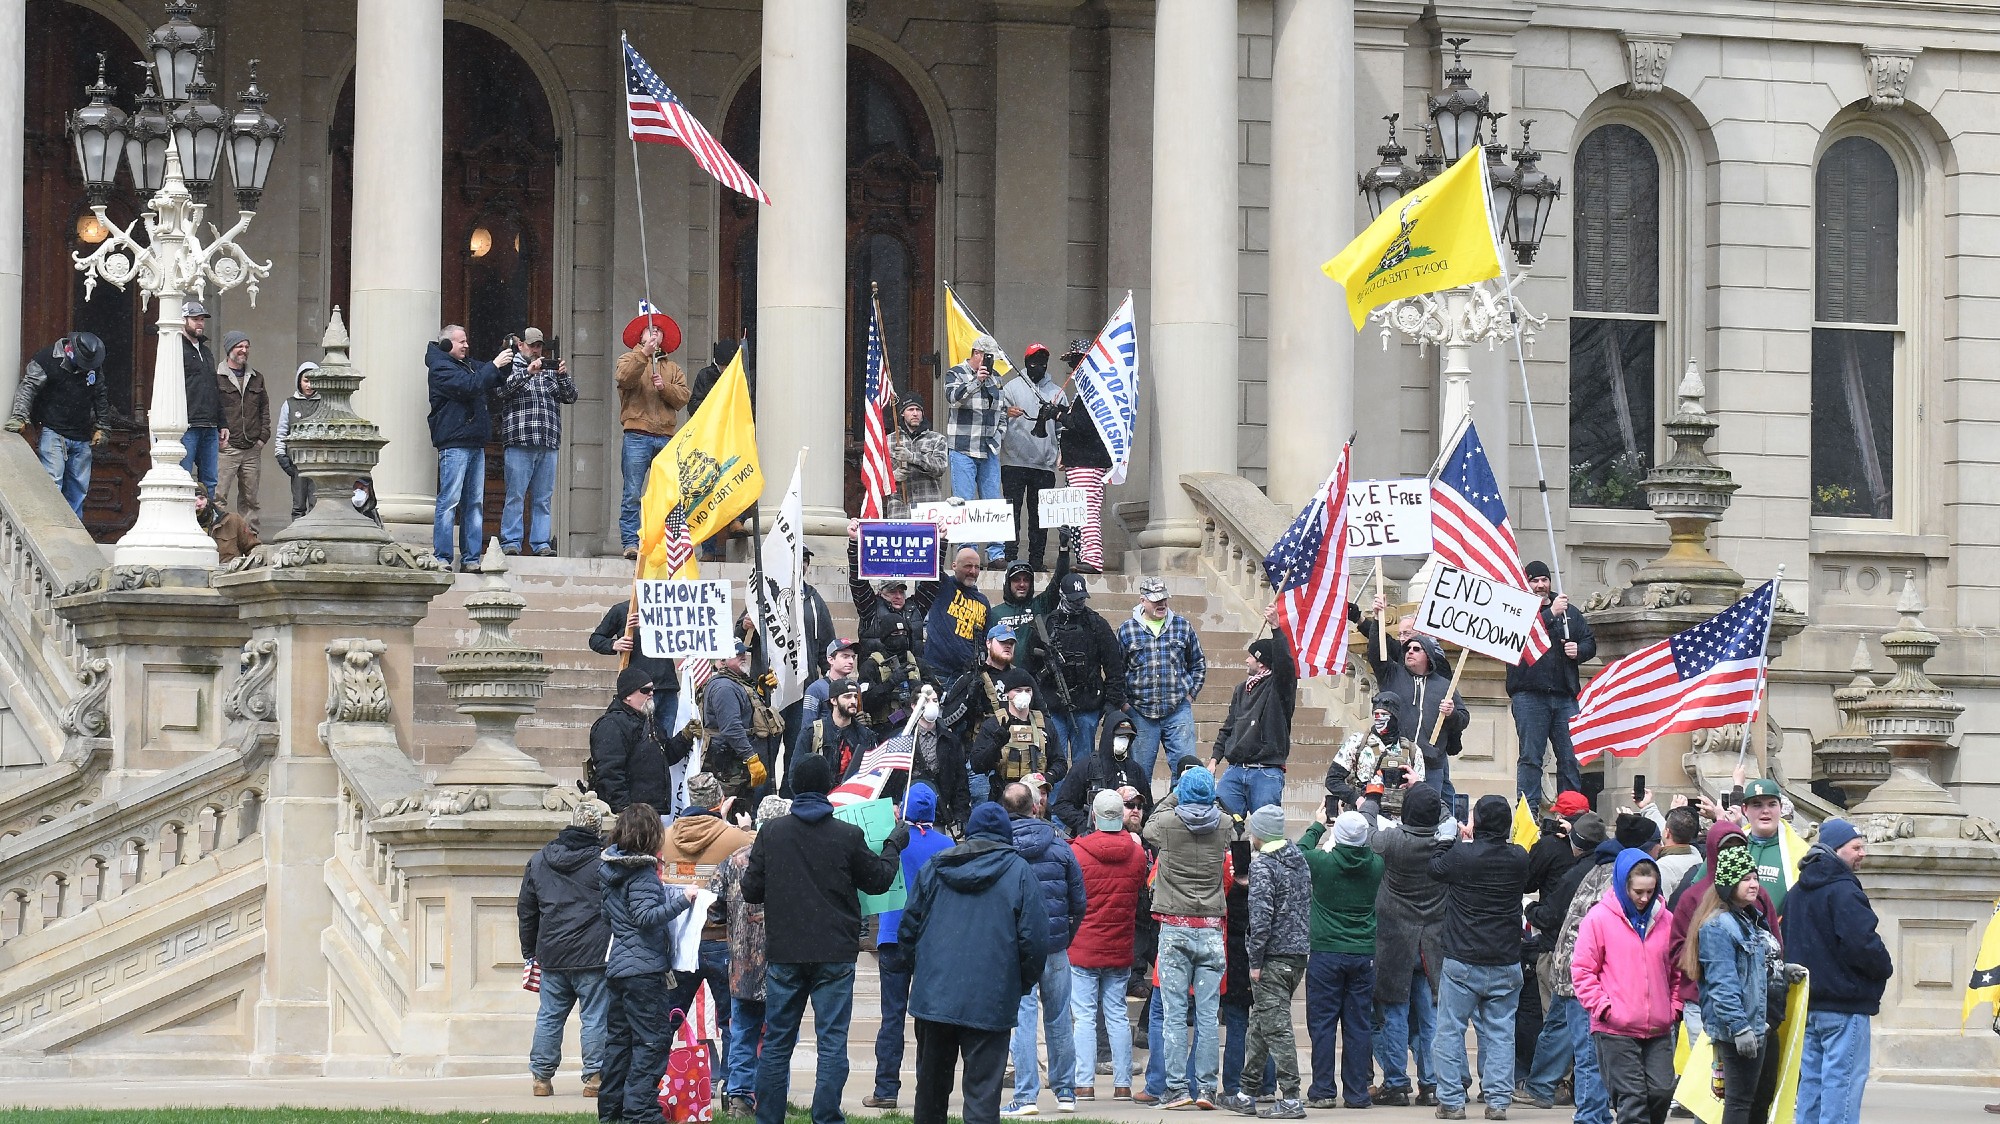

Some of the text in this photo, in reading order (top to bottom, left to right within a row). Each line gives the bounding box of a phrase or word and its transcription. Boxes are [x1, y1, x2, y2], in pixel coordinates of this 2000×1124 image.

[1090, 398, 1124, 462] BULLSHI
[1047, 507, 1086, 524] HITLER
[864, 536, 934, 548] TRUMP
[1348, 524, 1400, 547] DIE
[644, 582, 726, 604] REMOVE THE
[1434, 566, 1493, 606] END
[641, 606, 718, 627] WHITMER
[1502, 602, 1522, 617] THE
[1426, 600, 1527, 653] LOCKDOWN
[655, 629, 718, 654] REGIME
